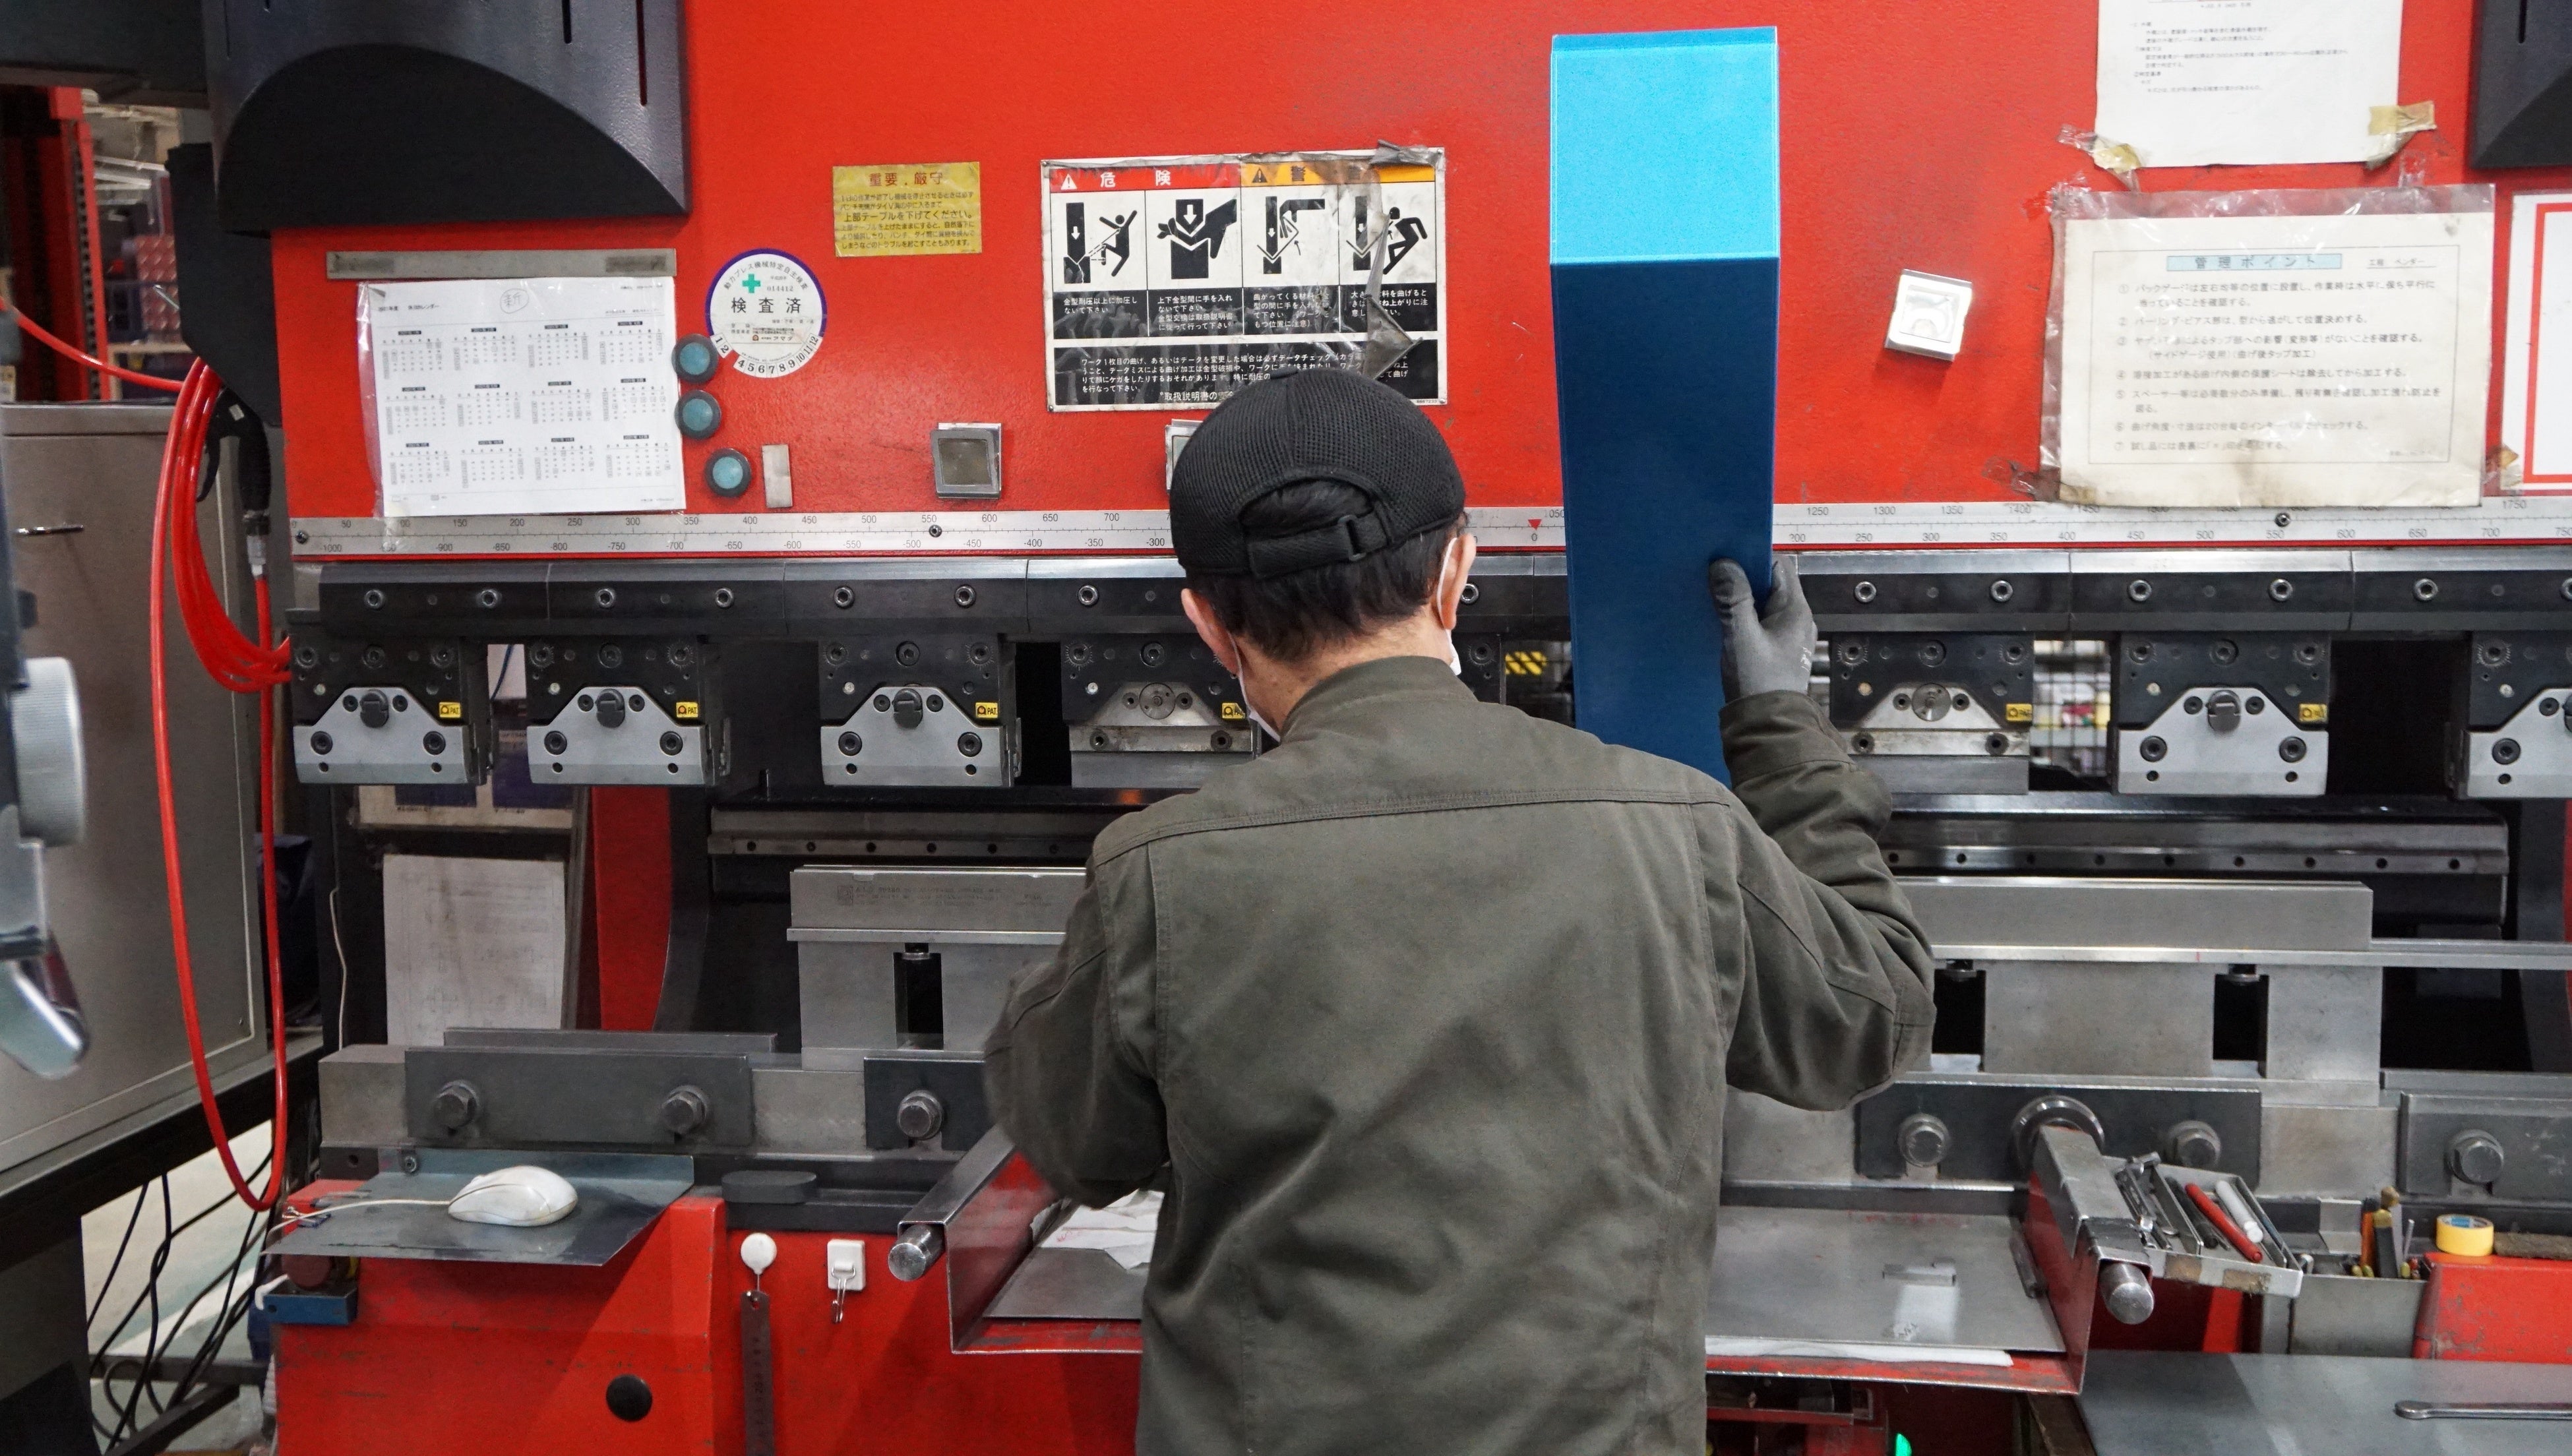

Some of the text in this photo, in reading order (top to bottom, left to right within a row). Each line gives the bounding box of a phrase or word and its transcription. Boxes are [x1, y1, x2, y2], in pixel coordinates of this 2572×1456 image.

[1099, 170, 1171, 188] 危険
[843, 210, 972, 222] 上部テーブルを下げてください。
[2195, 254, 2315, 269] 管理ポイント
[731, 297, 801, 313] 検査済
[1063, 296, 1138, 305] 金型耐圧以上に加圧し
[1157, 295, 1233, 304] 上下金型間に手を入れ
[721, 345, 729, 353] 2
[737, 359, 745, 368] 4
[747, 363, 755, 372] 5
[779, 363, 786, 372] 8
[787, 359, 795, 368] 9
[796, 353, 805, 363] 10
[804, 346, 812, 355] 11
[809, 336, 818, 346] 12
[454, 518, 468, 528] 150
[510, 518, 525, 527] 200
[567, 518, 582, 526] 250
[625, 517, 640, 526] 300
[684, 516, 699, 526] 350
[743, 516, 758, 525] 400
[801, 516, 817, 524] 450
[861, 515, 877, 524] 500
[921, 514, 937, 523] 550
[1043, 513, 1058, 522] 650
[1104, 512, 1120, 521] 700
[1807, 506, 1829, 516] 1250
[1874, 506, 1896, 515] 1300
[1941, 505, 1963, 514] 1350
[2009, 505, 2032, 514] 1400
[2503, 499, 2527, 509] 1750
[436, 543, 453, 552] -900
[493, 543, 510, 551] -850
[551, 543, 568, 551] -800
[666, 541, 684, 550] -700
[725, 541, 743, 549] -650
[783, 540, 802, 549] -600
[843, 540, 861, 549] -550
[903, 539, 921, 548] -500
[1146, 538, 1165, 547] -300
[1531, 533, 1538, 541] 0
[1855, 533, 1873, 541] 250
[1922, 533, 1940, 541] 300
[1990, 532, 2008, 541] 350
[2058, 531, 2076, 541] 400
[2126, 531, 2145, 540] 450
[2196, 530, 2215, 539] 500
[2266, 530, 2284, 539] 550
[2337, 529, 2356, 538] 600
[2408, 528, 2428, 537] 650
[2482, 528, 2501, 537] 700
[987, 707, 998, 715] PAT.
